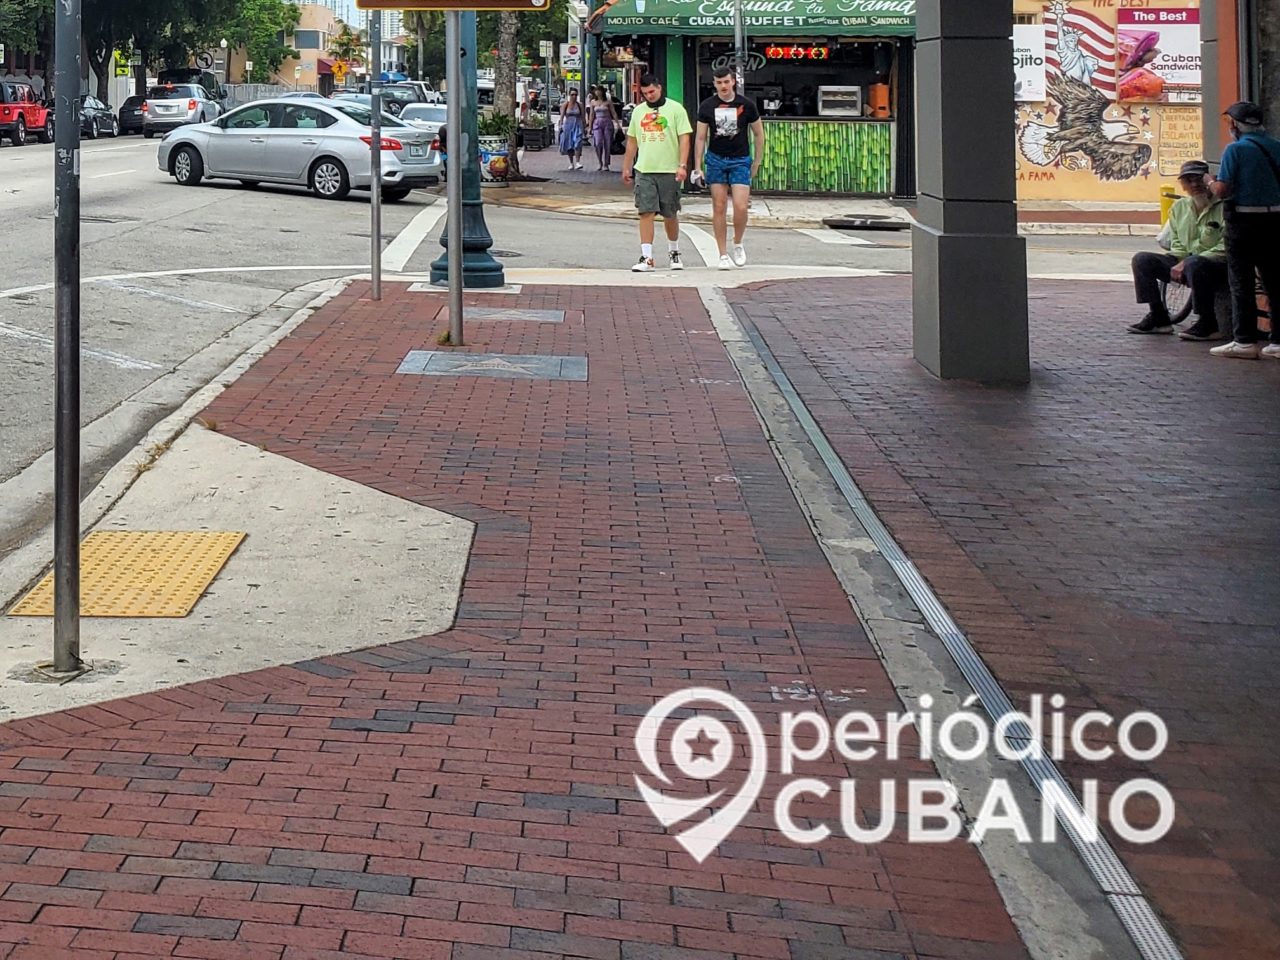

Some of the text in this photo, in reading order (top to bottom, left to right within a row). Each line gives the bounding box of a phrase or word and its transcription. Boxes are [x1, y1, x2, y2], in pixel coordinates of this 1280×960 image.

[607, 17, 644, 25] MOJITO
[650, 13, 680, 25] CAFÉ
[689, 16, 734, 26] CUBAN
[743, 16, 806, 26] BUFFET
[842, 16, 868, 26] CUBAN
[870, 16, 910, 26] SANDWICH
[1133, 11, 1187, 21] The Best
[1161, 53, 1201, 62] Cuban
[716, 56, 759, 71] OPN
[1150, 62, 1201, 71] Sandwich
[1028, 172, 1055, 180] FAMA
